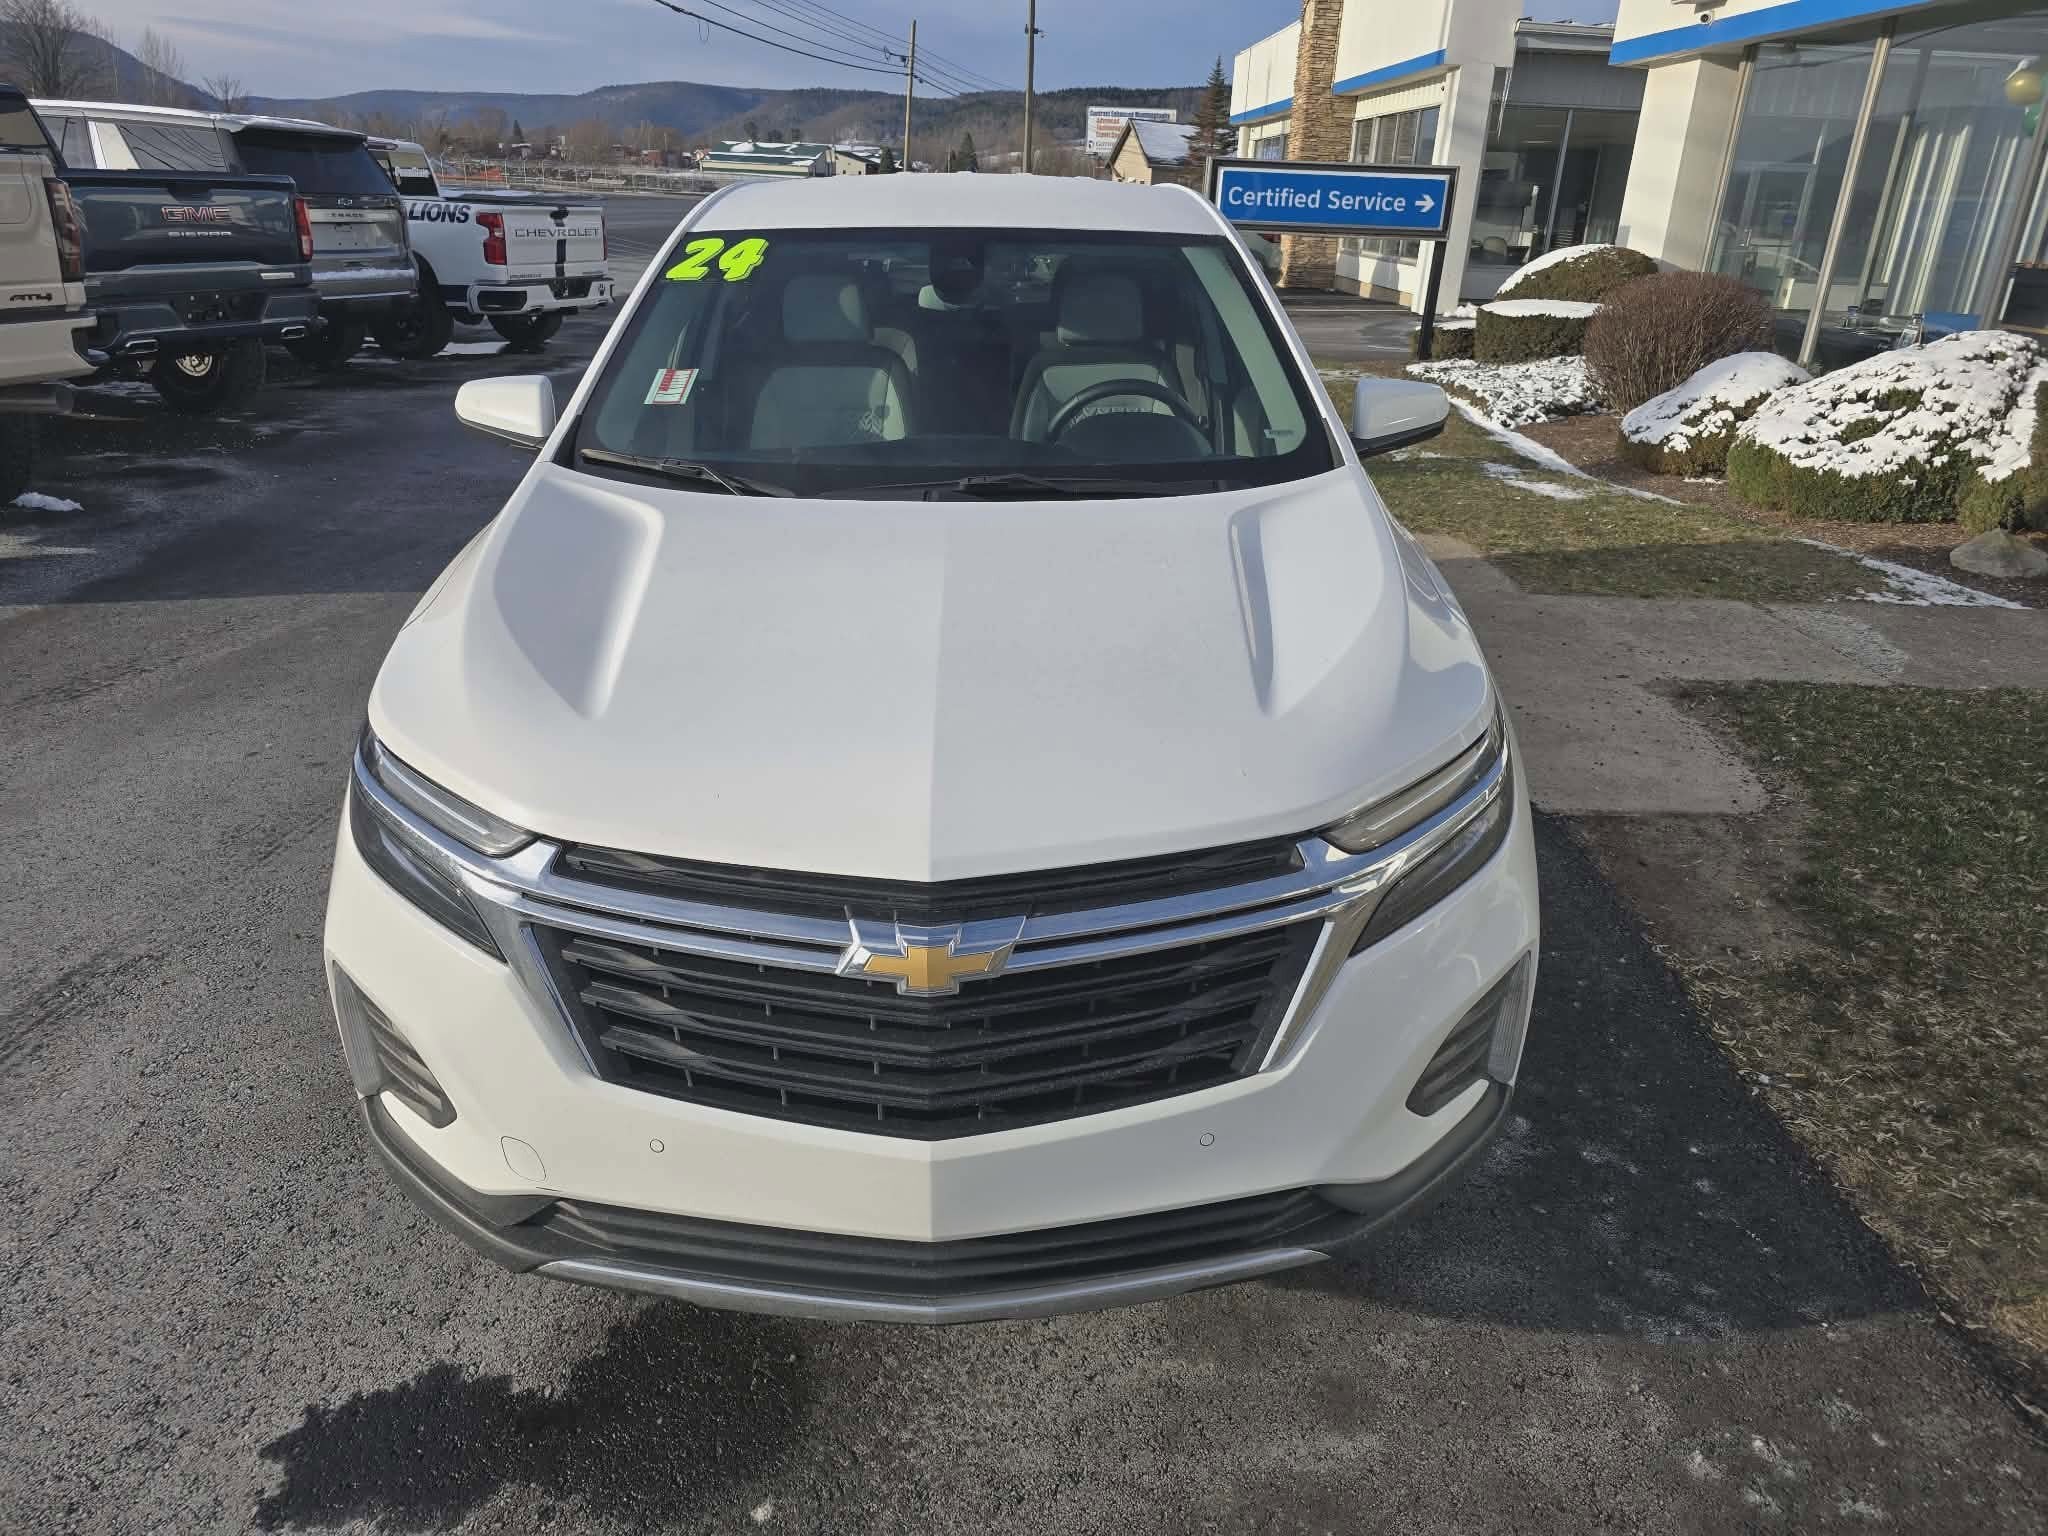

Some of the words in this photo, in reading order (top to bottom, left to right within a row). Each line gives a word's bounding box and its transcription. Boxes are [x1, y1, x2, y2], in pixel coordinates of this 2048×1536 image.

[1228, 186, 1320, 209] Certified
[1327, 190, 1406, 212] Service
[160, 206, 233, 223] GMC
[408, 202, 471, 224] LIONS
[513, 227, 601, 239] CHEVROLET
[664, 237, 770, 282] 24
